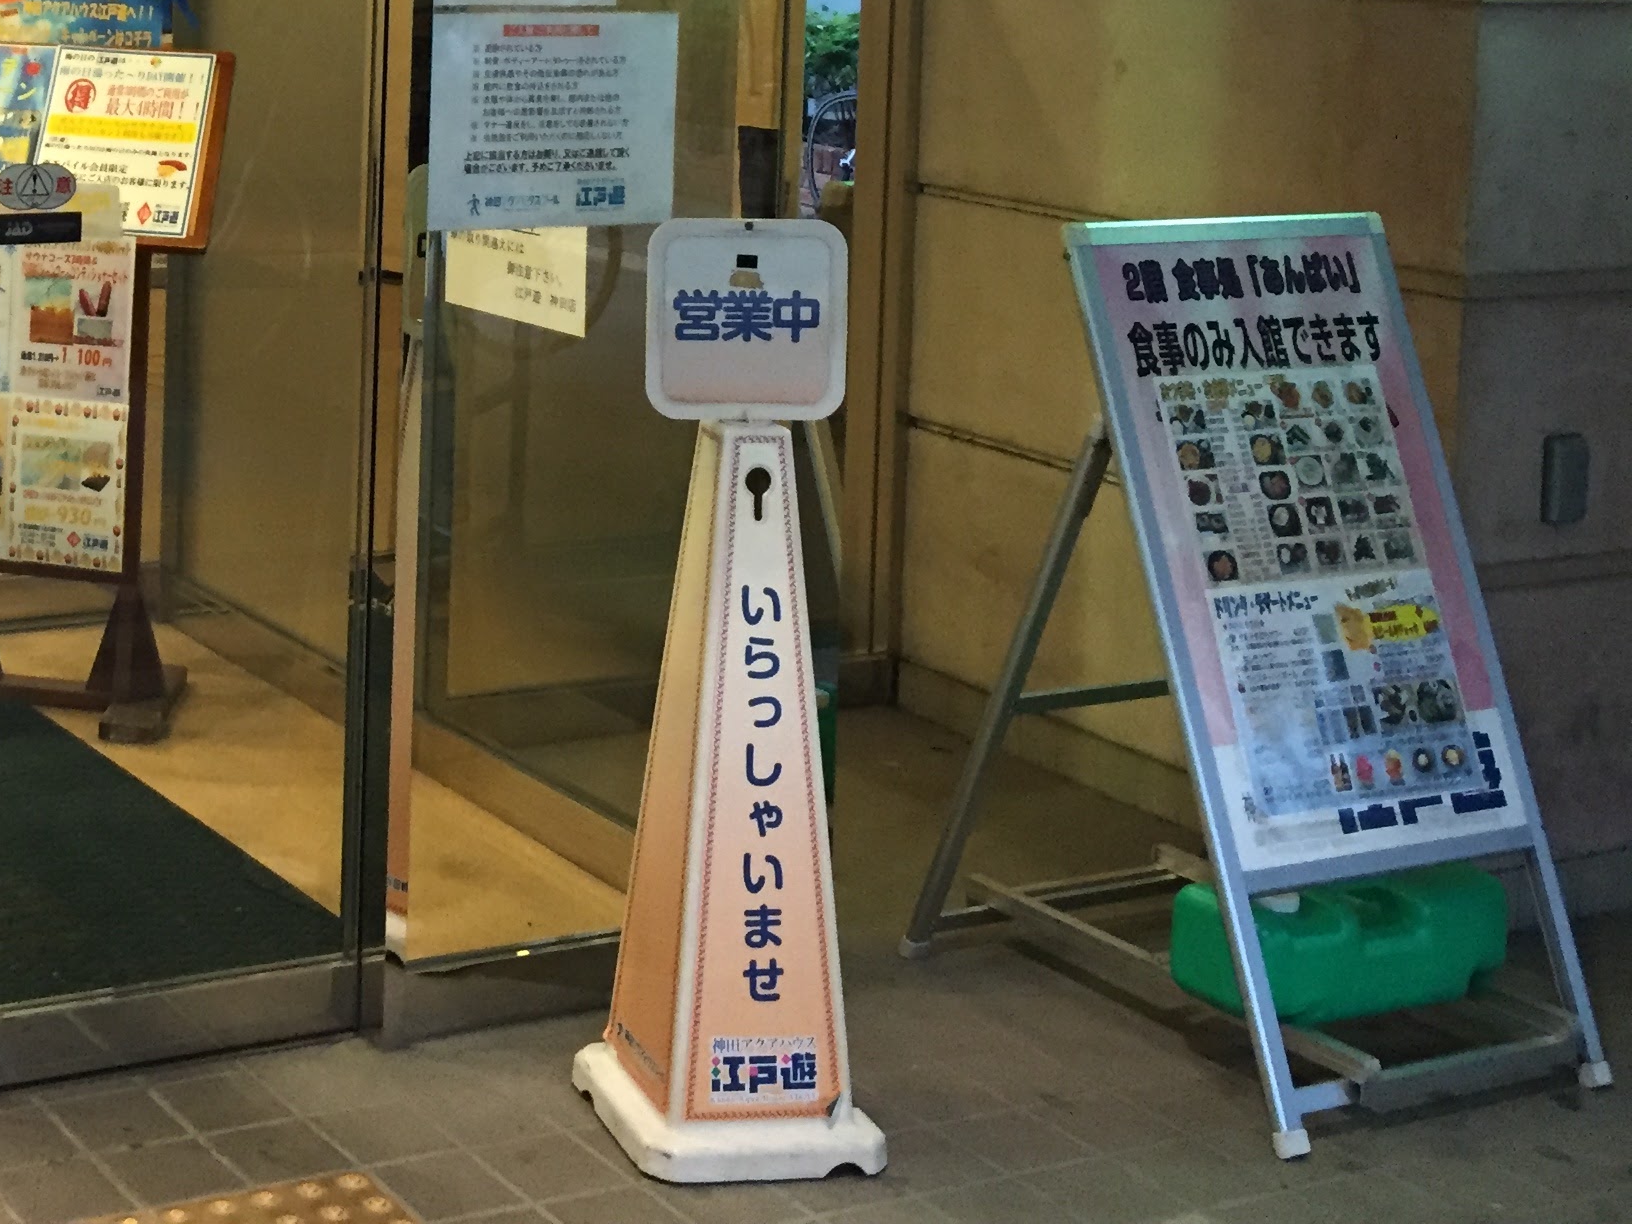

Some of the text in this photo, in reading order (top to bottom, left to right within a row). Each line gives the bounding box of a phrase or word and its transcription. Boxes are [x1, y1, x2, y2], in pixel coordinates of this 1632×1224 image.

[672, 289, 821, 344] 営業中
[1127, 310, 1382, 378] 食事のみ入館できます
[741, 584, 784, 1003] いらっしゃいませ
[711, 1051, 817, 1094] 江戸遊
